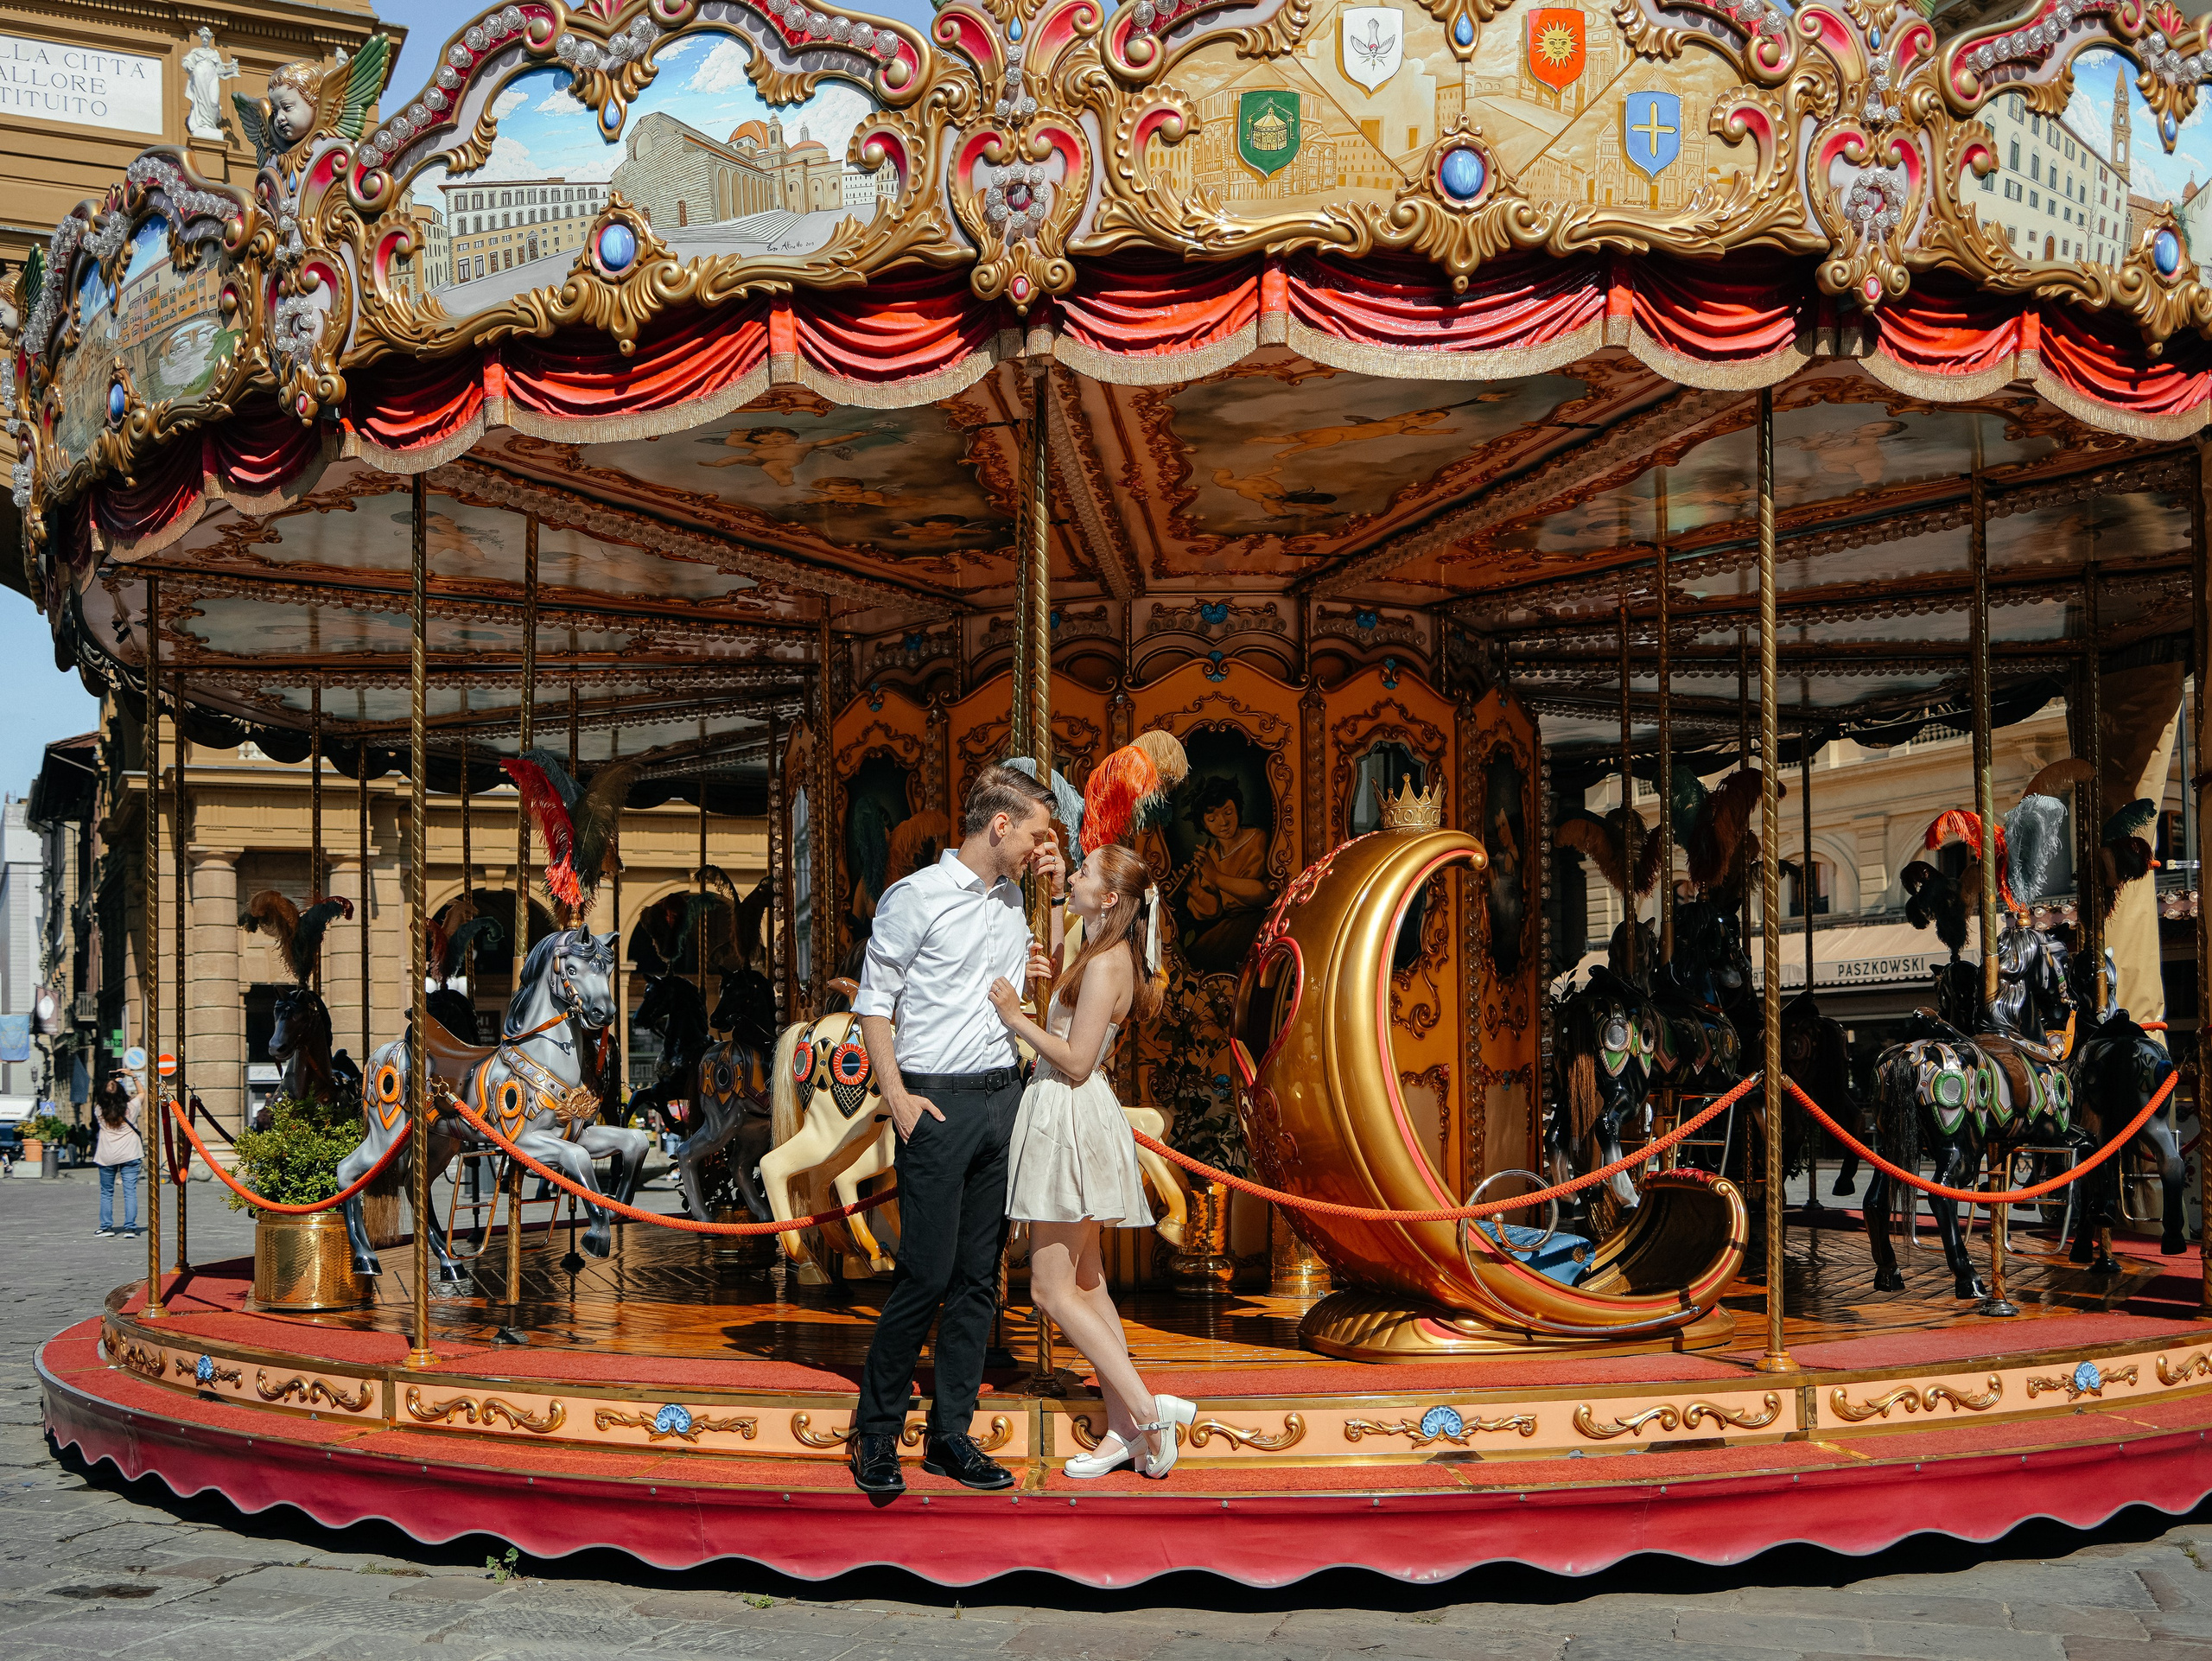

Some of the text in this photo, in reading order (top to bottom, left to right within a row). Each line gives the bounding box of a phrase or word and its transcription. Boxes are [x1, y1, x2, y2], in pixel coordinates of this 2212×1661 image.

[64, 52, 145, 79] CITTÀ
[0, 87, 107, 116] TITUITO
[1838, 958, 1924, 977] PASZKOWSKI
